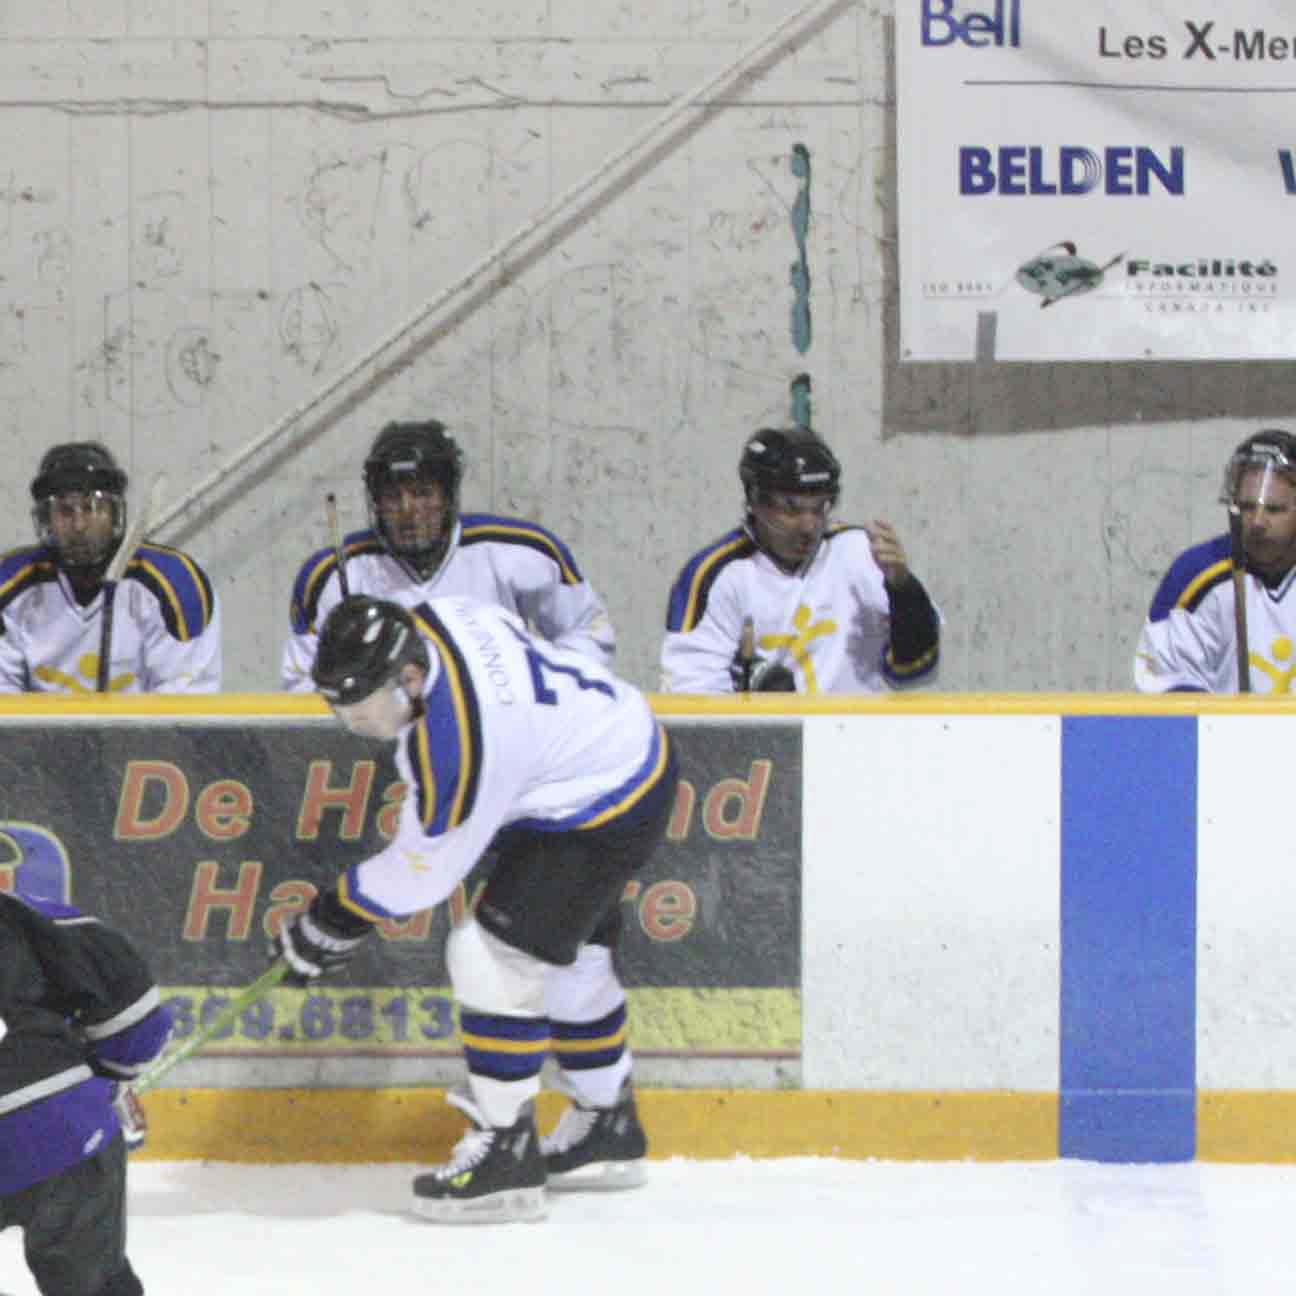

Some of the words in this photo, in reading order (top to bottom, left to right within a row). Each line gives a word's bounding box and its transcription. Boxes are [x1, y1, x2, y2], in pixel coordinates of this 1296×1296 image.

[921, 0, 1022, 47] Bell
[1098, 26, 1168, 60] Les
[1182, 20, 1296, 61] X-Me
[959, 146, 1185, 196] BELDEN
[1125, 258, 1278, 278] Facilité
[113, 760, 254, 841] De
